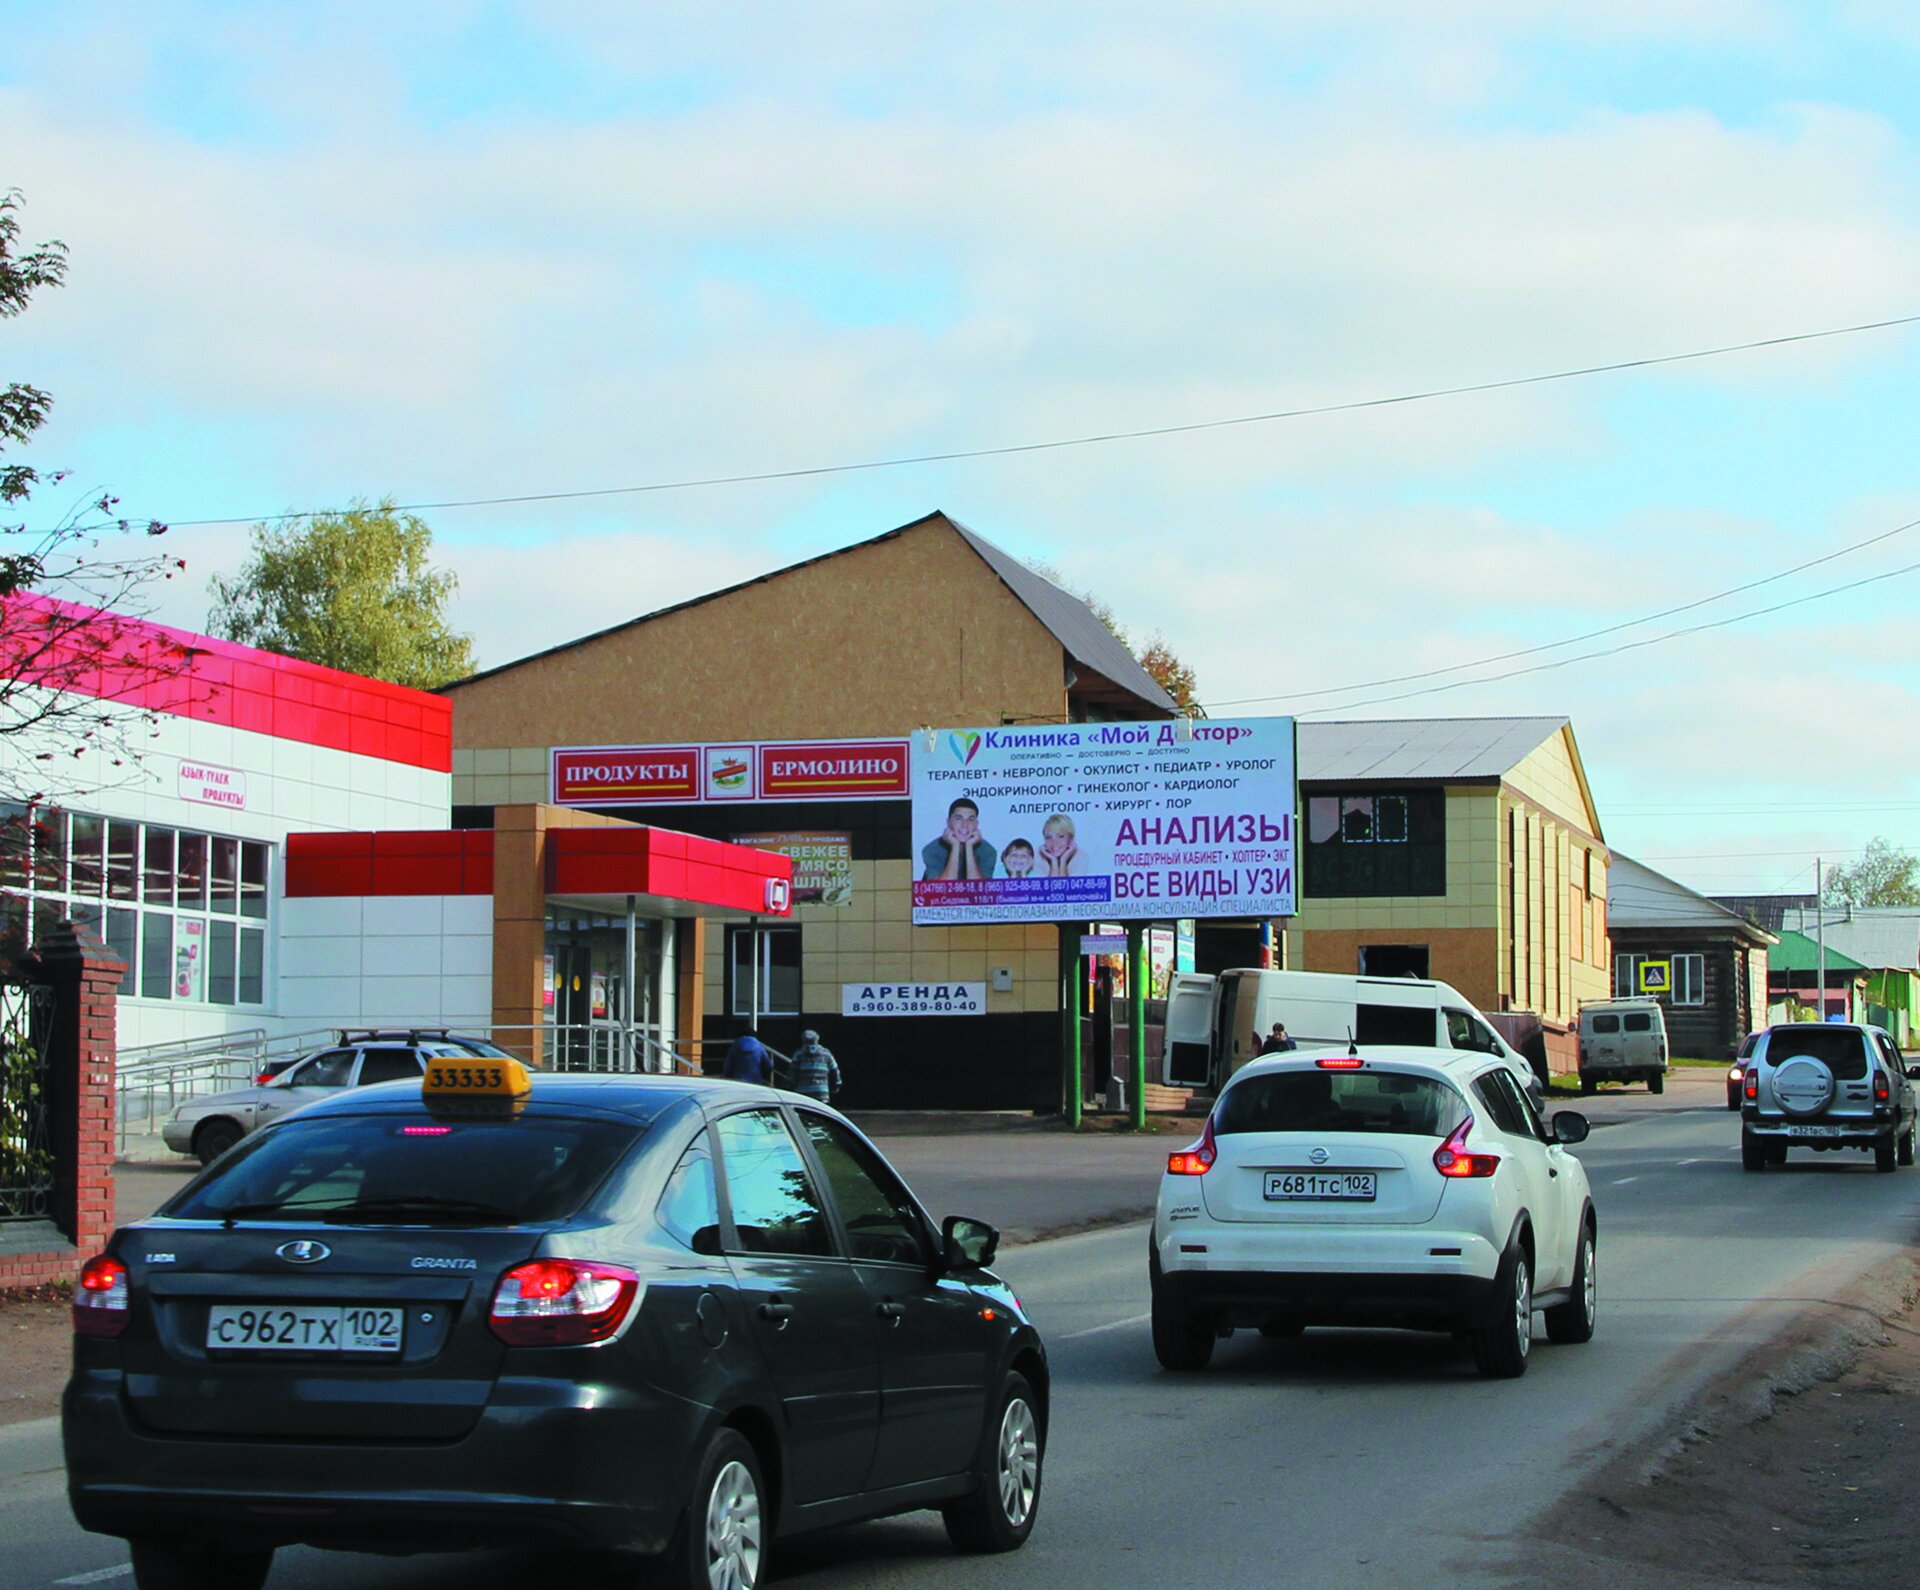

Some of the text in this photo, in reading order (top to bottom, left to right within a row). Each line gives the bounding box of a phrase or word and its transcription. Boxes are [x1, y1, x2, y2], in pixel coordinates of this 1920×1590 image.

[985, 725, 1253, 749] Клиника «Мой Дктор»
[1010, 747, 1190, 761] ОПЕРАТИВНО ДОСТОВЕРНО ДОСТУПНО
[566, 763, 689, 782] ПРОДУКТЫ
[771, 758, 898, 778] ЕРМОЛИНО
[927, 759, 1276, 781] ТЕРАПЕВТ НЕВРОЛОГ ОКУЛИСТ ПЕДИАТР УРОЛОГ
[202, 787, 244, 805] ПРОДУКТЫ
[962, 778, 1240, 798] ЭНДОКРИНОЛОГ ГИНЕКОЛОГ КАРДИОЛОГ
[1009, 798, 1192, 814] АЛЛЕРГОЛОГ ХИРУРГ ЛОР
[1115, 814, 1290, 846] АНАЛИЗЫ
[779, 845, 848, 858] СВЕЖЕЕ
[1114, 848, 1290, 867] ПРОЦЕДУРНЫЙ КАБИНЕТ ХОЛТЕР ЭКГ
[800, 860, 848, 872] МЯСО
[978, 881, 983, 892] 8
[1043, 879, 1049, 890] 8
[1114, 867, 1290, 901] ВСЕ ВИДЫ УЗИ
[915, 907, 962, 921] ИМЕЮТСЯ
[1072, 902, 1140, 917] НЕОБХОДИМА
[1143, 900, 1218, 915] КОНСУЛЬТАЦИЯ
[1220, 898, 1292, 914] СПЕЦИАЛИСТА
[861, 986, 968, 1000] АРЕНДА
[852, 1001, 977, 1012] 8-960-389-80-40
[430, 1068, 502, 1088] 33333
[1344, 1175, 1370, 1190] 102
[411, 1257, 477, 1269] GRANTA
[346, 1310, 394, 1336] 102
[355, 1337, 380, 1347] RUS
